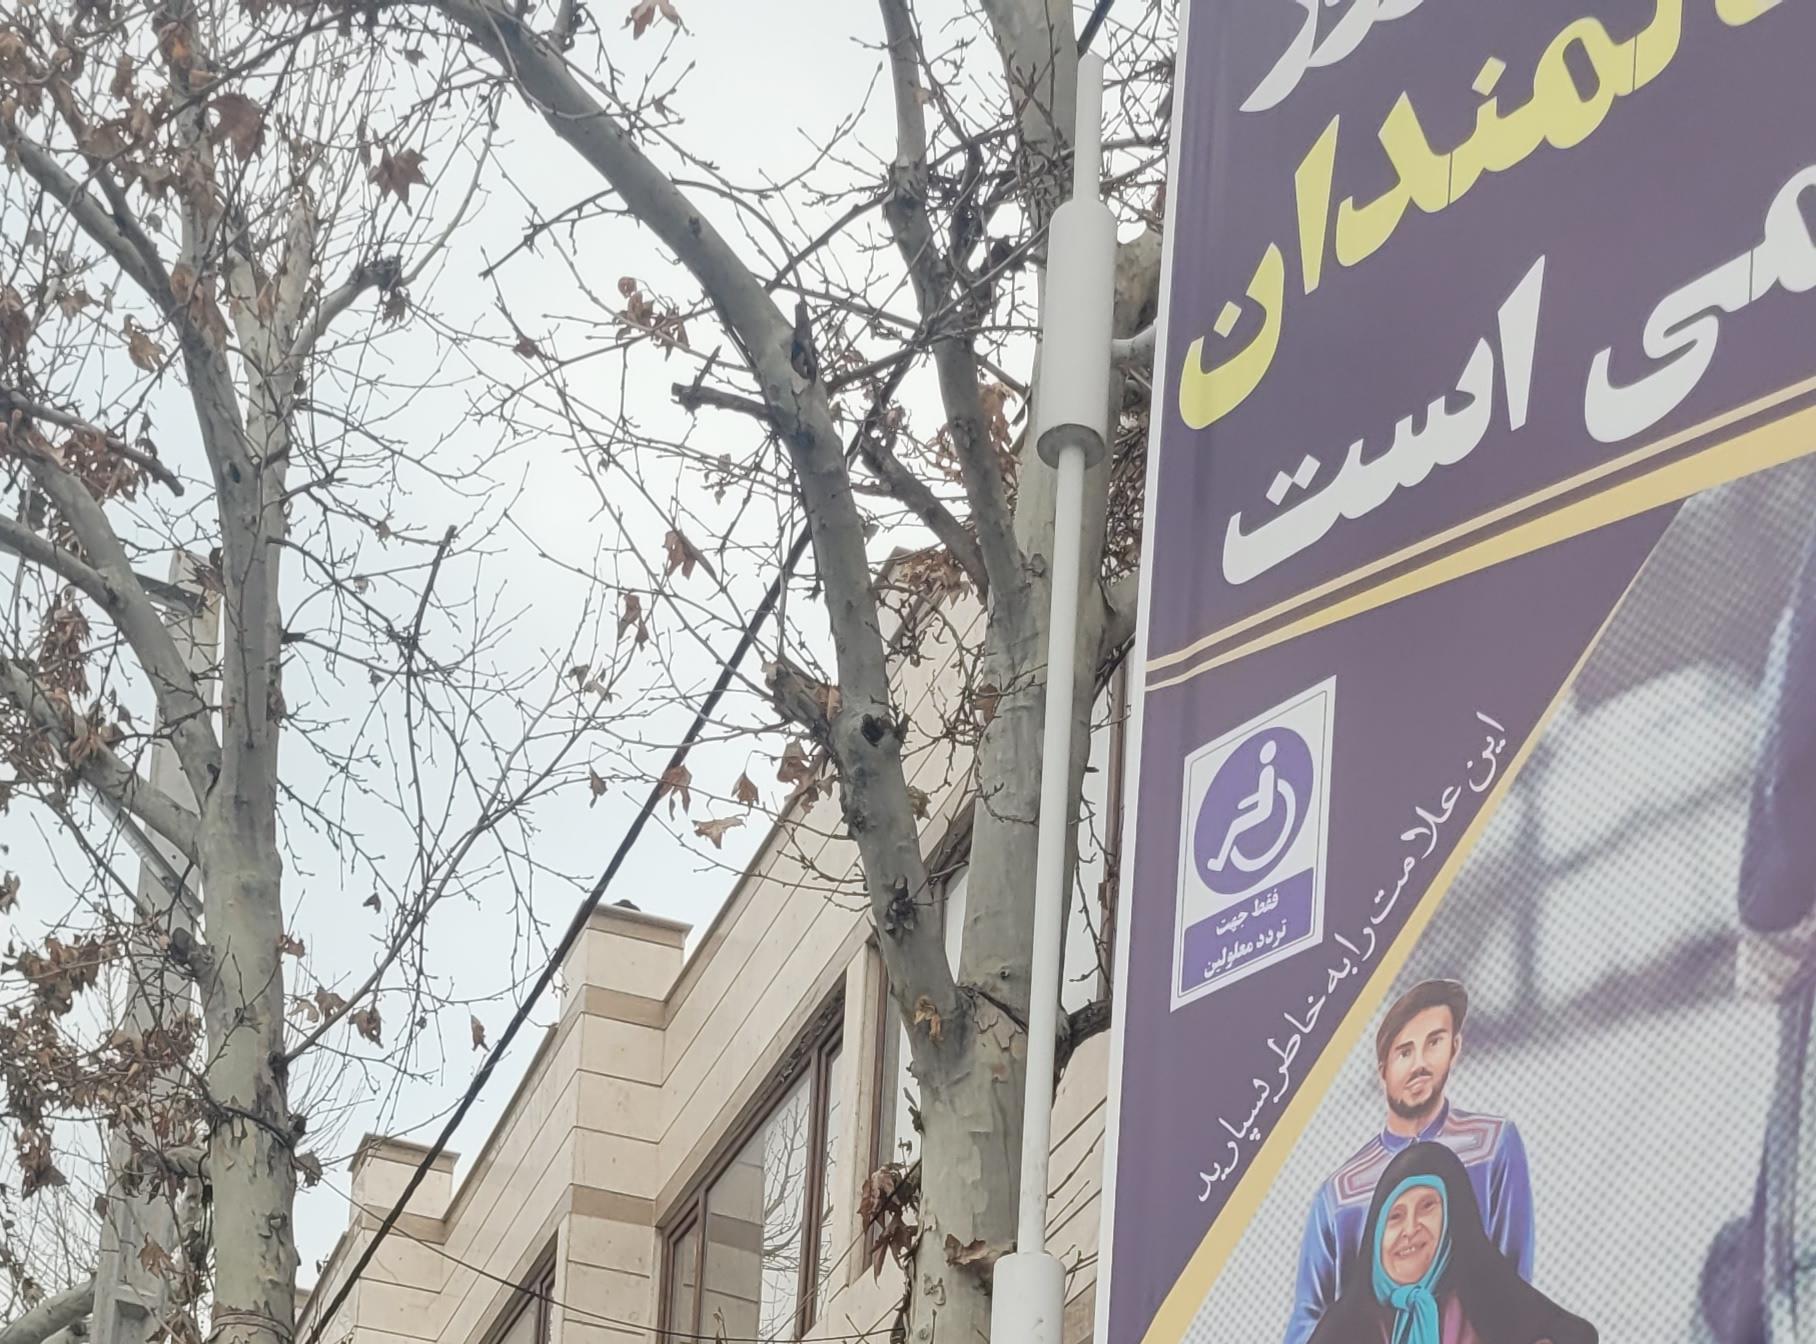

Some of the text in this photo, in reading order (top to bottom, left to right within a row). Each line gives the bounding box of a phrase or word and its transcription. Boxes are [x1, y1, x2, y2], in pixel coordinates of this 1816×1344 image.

[1179, 0, 1785, 431] لمندان
[1221, 254, 1546, 586] است
[1466, 711, 1506, 792] این
[1370, 784, 1461, 924] علامت
[1203, 918, 1287, 979] تردد معلولین
[1216, 888, 1279, 936] فقط جهت
[1334, 927, 1376, 962] را
[1327, 957, 1359, 993] به
[1267, 995, 1326, 1103] خاطر
